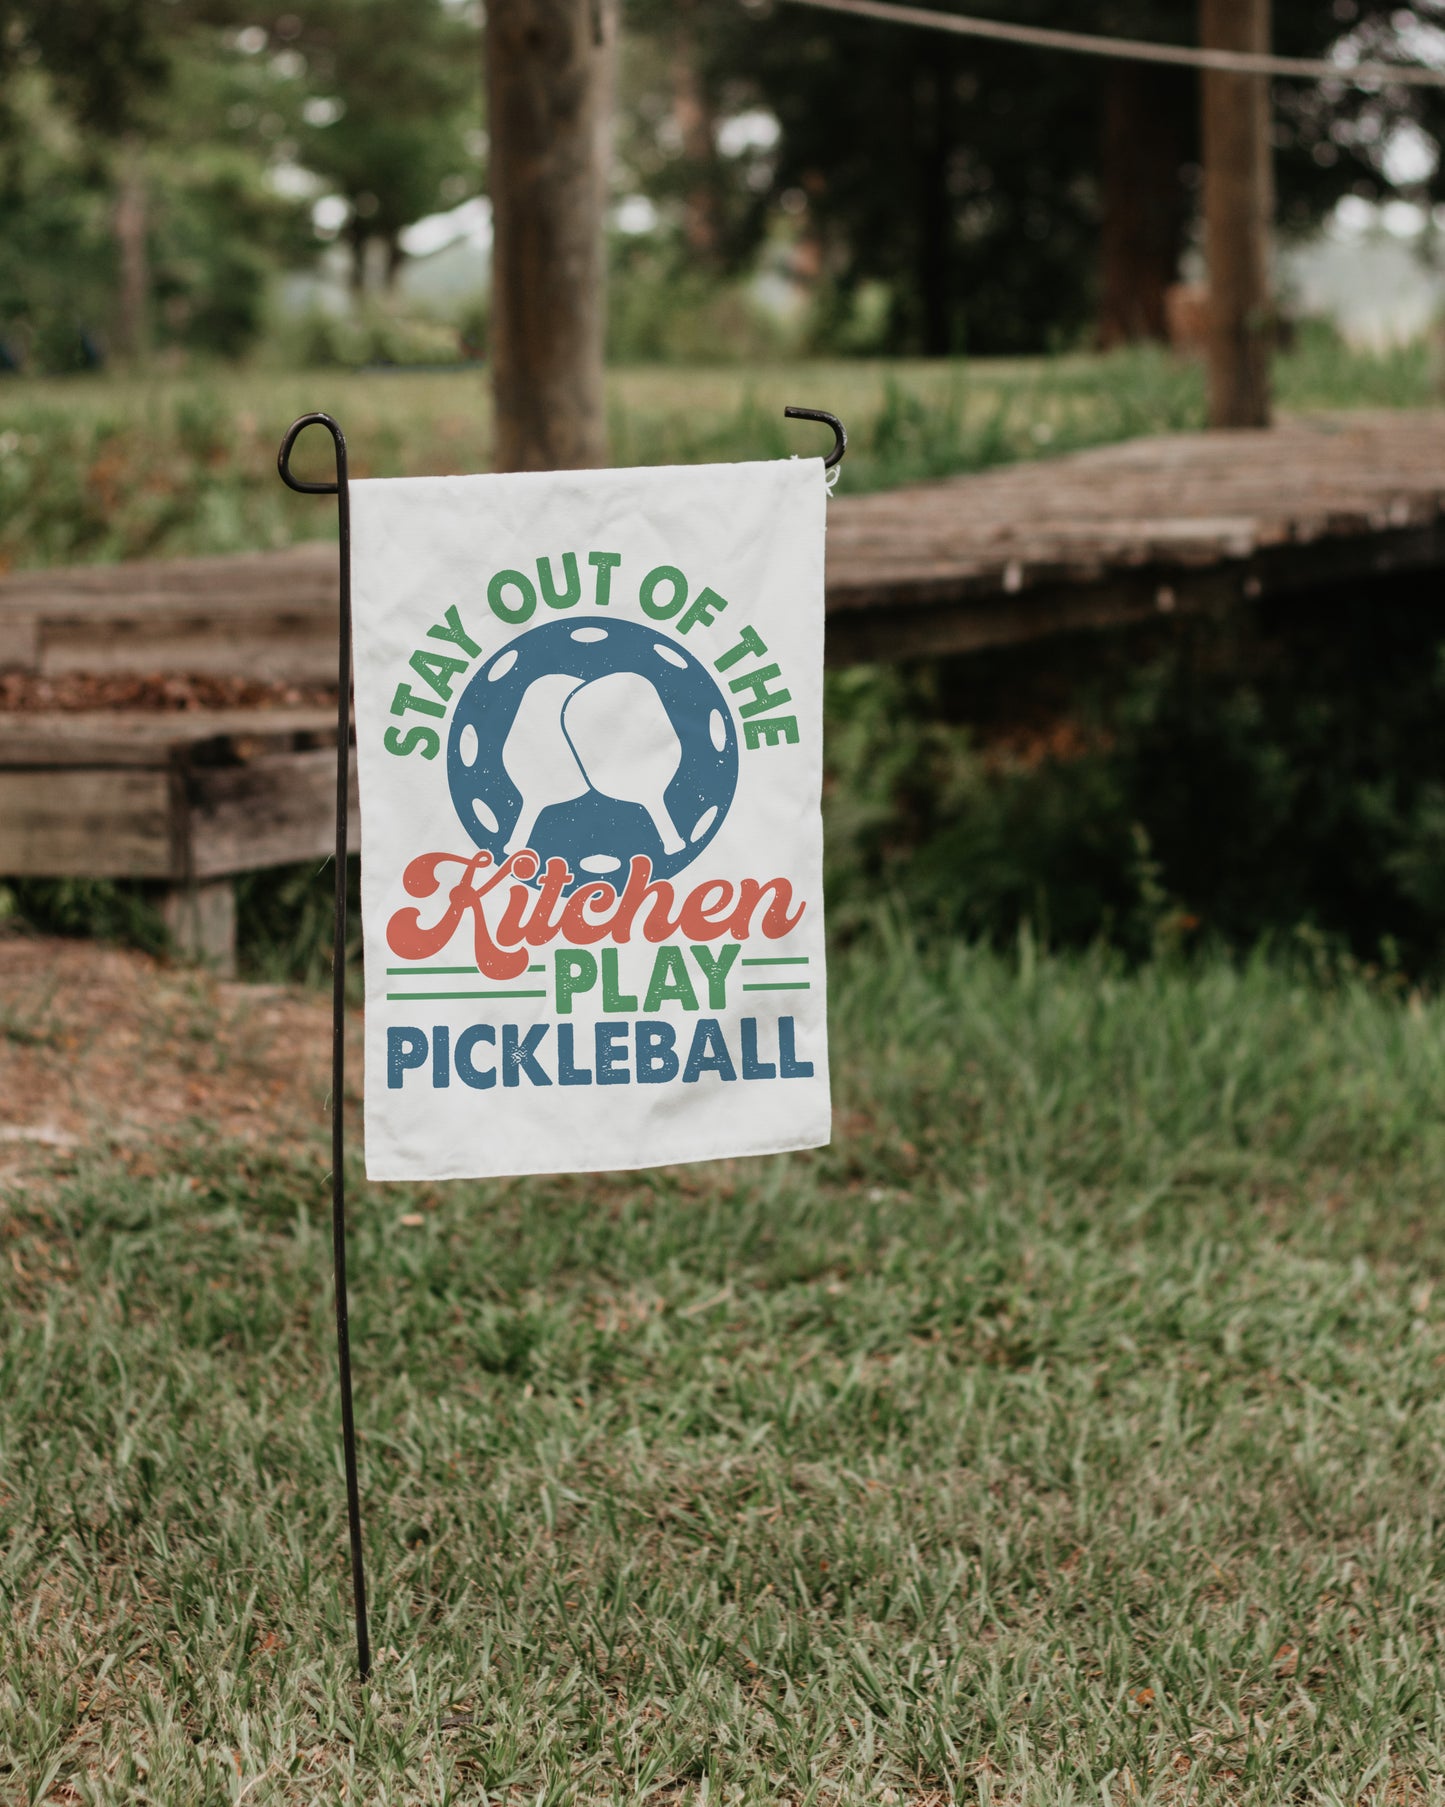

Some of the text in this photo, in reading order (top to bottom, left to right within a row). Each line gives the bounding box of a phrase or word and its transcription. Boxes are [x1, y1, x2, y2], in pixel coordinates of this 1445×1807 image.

[384, 551, 800, 760] STAY OUT OF THE
[386, 850, 806, 980] Kitchen
[555, 944, 741, 1014] PLAY
[387, 1016, 814, 1090] PICKLEBALL
